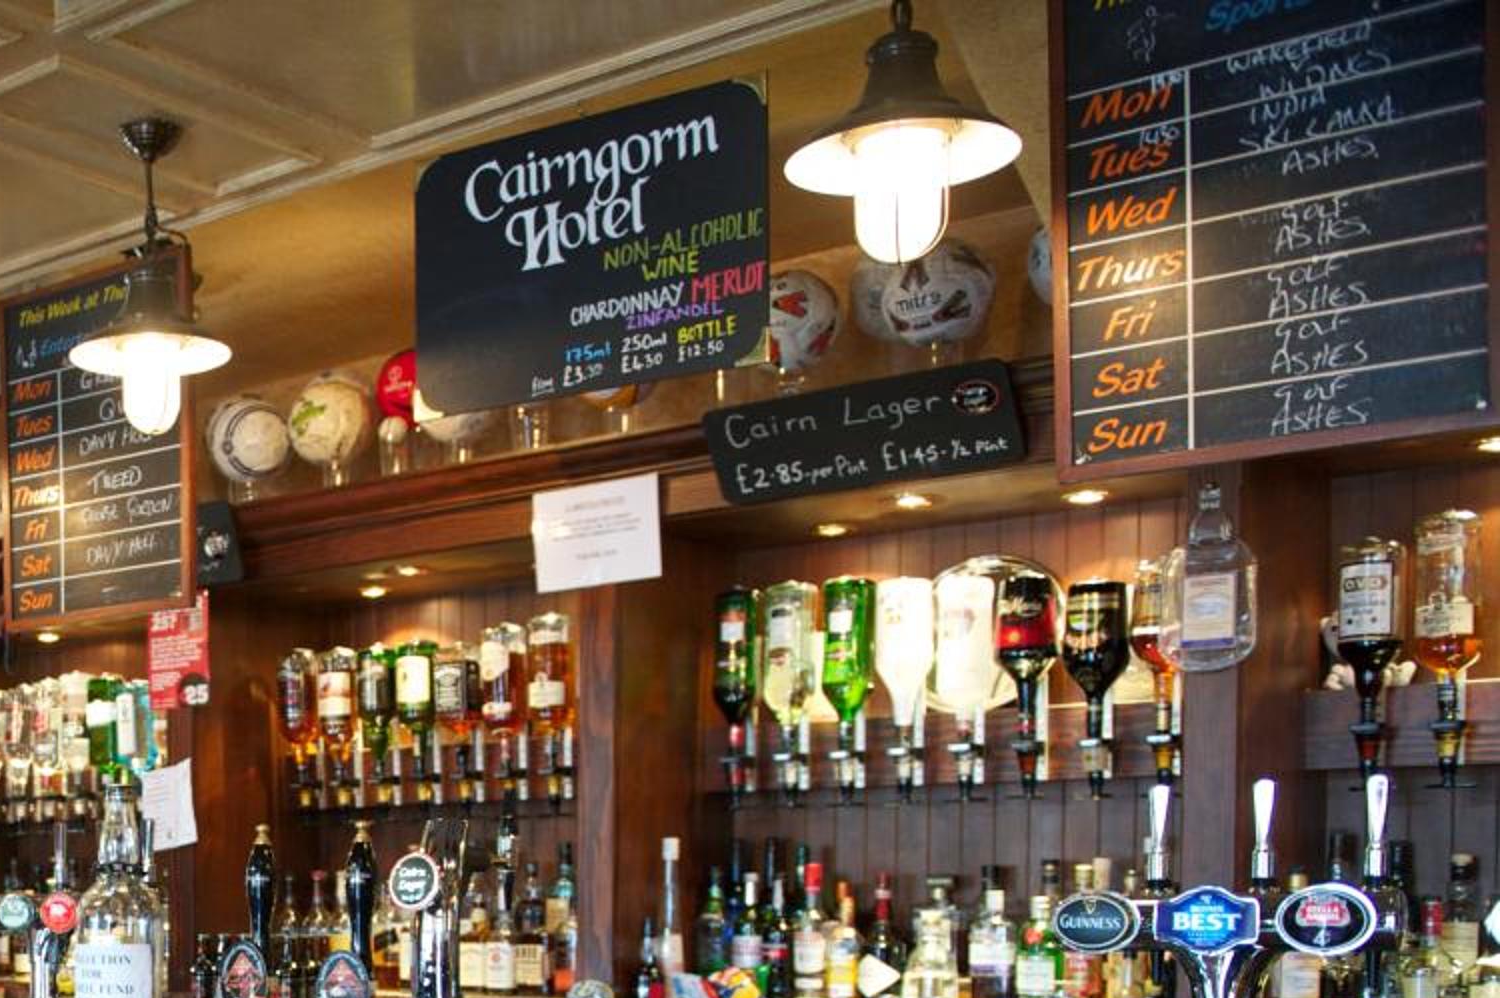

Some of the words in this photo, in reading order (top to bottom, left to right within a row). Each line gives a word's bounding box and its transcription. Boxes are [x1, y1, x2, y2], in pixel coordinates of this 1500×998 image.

[1080, 84, 1172, 129] Mon
[465, 115, 719, 222] Cairngorm
[1089, 143, 1172, 181] Tues
[505, 176, 649, 271] Hotel
[1086, 187, 1176, 236] Wed
[603, 208, 764, 271] NON-ALCOHOLIC
[642, 251, 700, 281] WINE
[1079, 248, 1185, 292] Thurs
[20, 307, 45, 329] This
[47, 293, 81, 321] Week
[570, 281, 685, 326] CHARDONNAY
[691, 261, 767, 305] MERLOT
[626, 302, 724, 331] ZINFANDEL
[1104, 300, 1157, 342] Fri
[564, 341, 612, 363] 175ml
[621, 331, 667, 353] 250ml
[676, 314, 738, 345] BOTTLE
[13, 376, 52, 401] Mon
[1092, 357, 1164, 399] Sat
[15, 412, 52, 437] Tues
[723, 413, 818, 450] Cairn
[842, 394, 941, 430] Lager
[1089, 417, 1167, 455] Sun
[15, 445, 55, 472] Wed
[12, 485, 59, 510] Thurs
[24, 518, 49, 542] Fri
[20, 553, 51, 577] Sat
[19, 590, 54, 614] Sun
[184, 684, 210, 705] 25
[1060, 912, 1122, 930] GUINNESS
[1172, 911, 1242, 931] BEST
